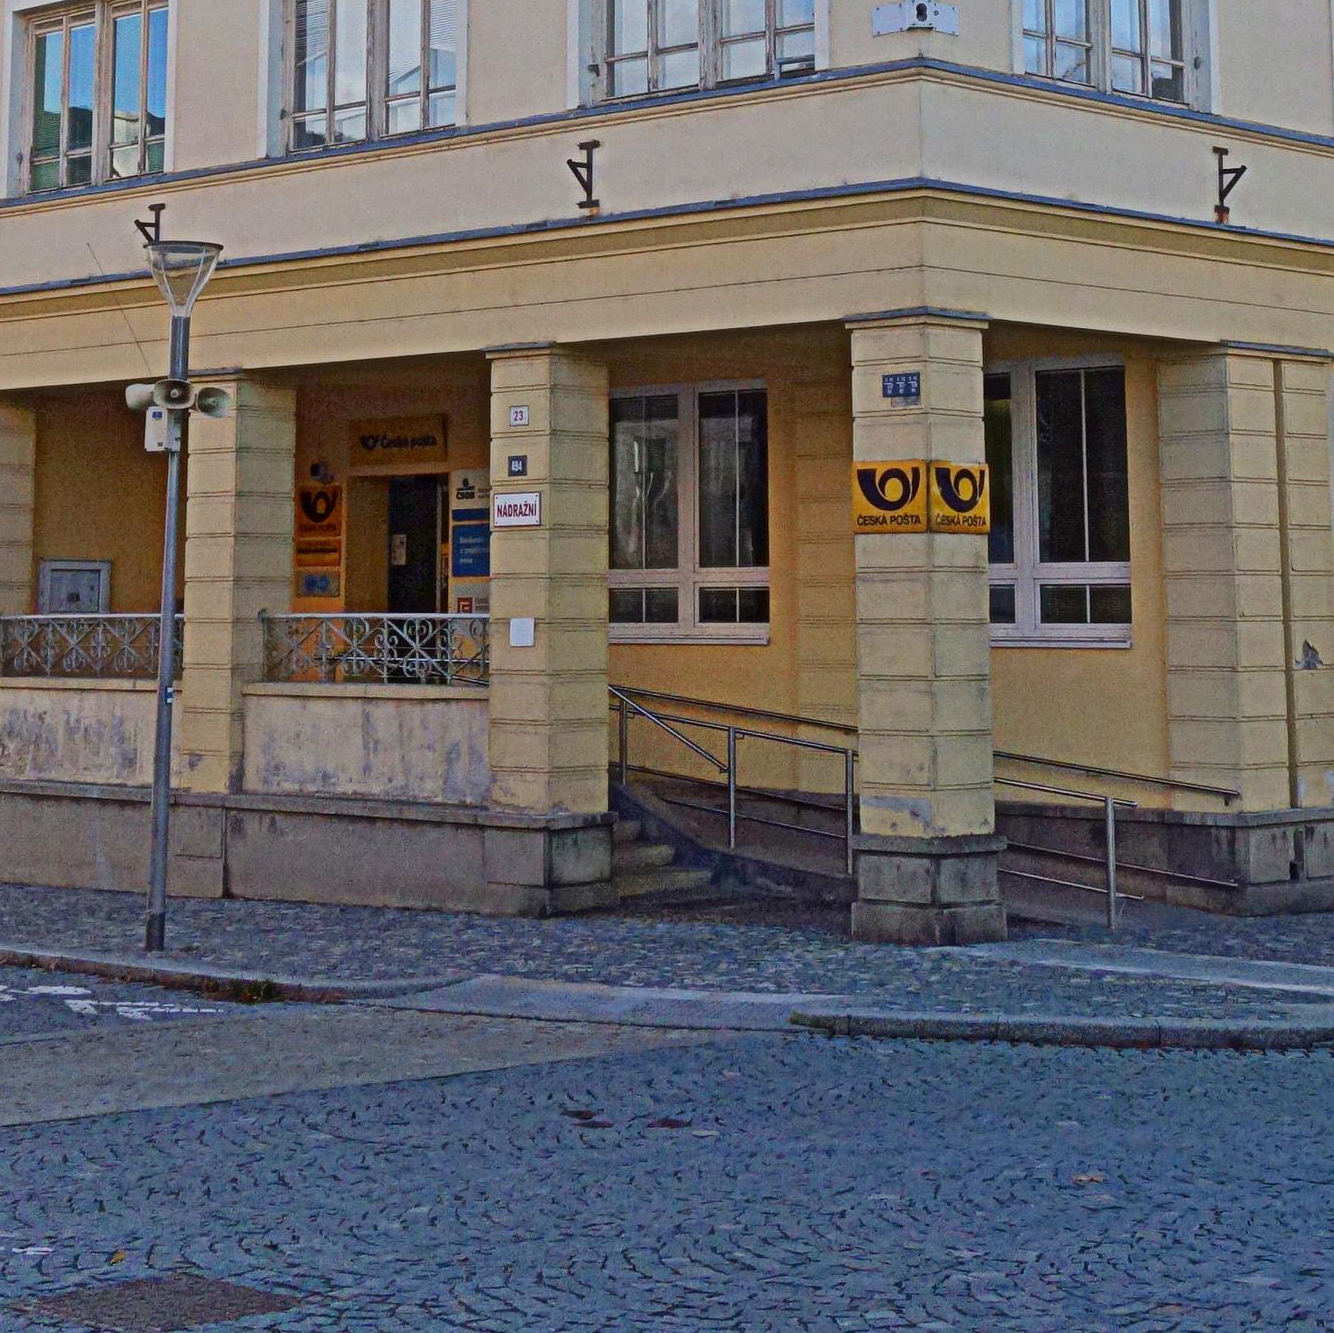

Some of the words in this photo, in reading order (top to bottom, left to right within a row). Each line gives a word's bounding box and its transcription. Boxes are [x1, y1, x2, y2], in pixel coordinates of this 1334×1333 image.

[513, 410, 524, 422] 23
[497, 500, 537, 518] NÁDRAŽNÍ
[857, 513, 887, 526] ČESKÁ
[889, 513, 922, 526] POŠTA
[936, 514, 962, 526] ČESKÁ
[962, 515, 987, 527] POŠTA
